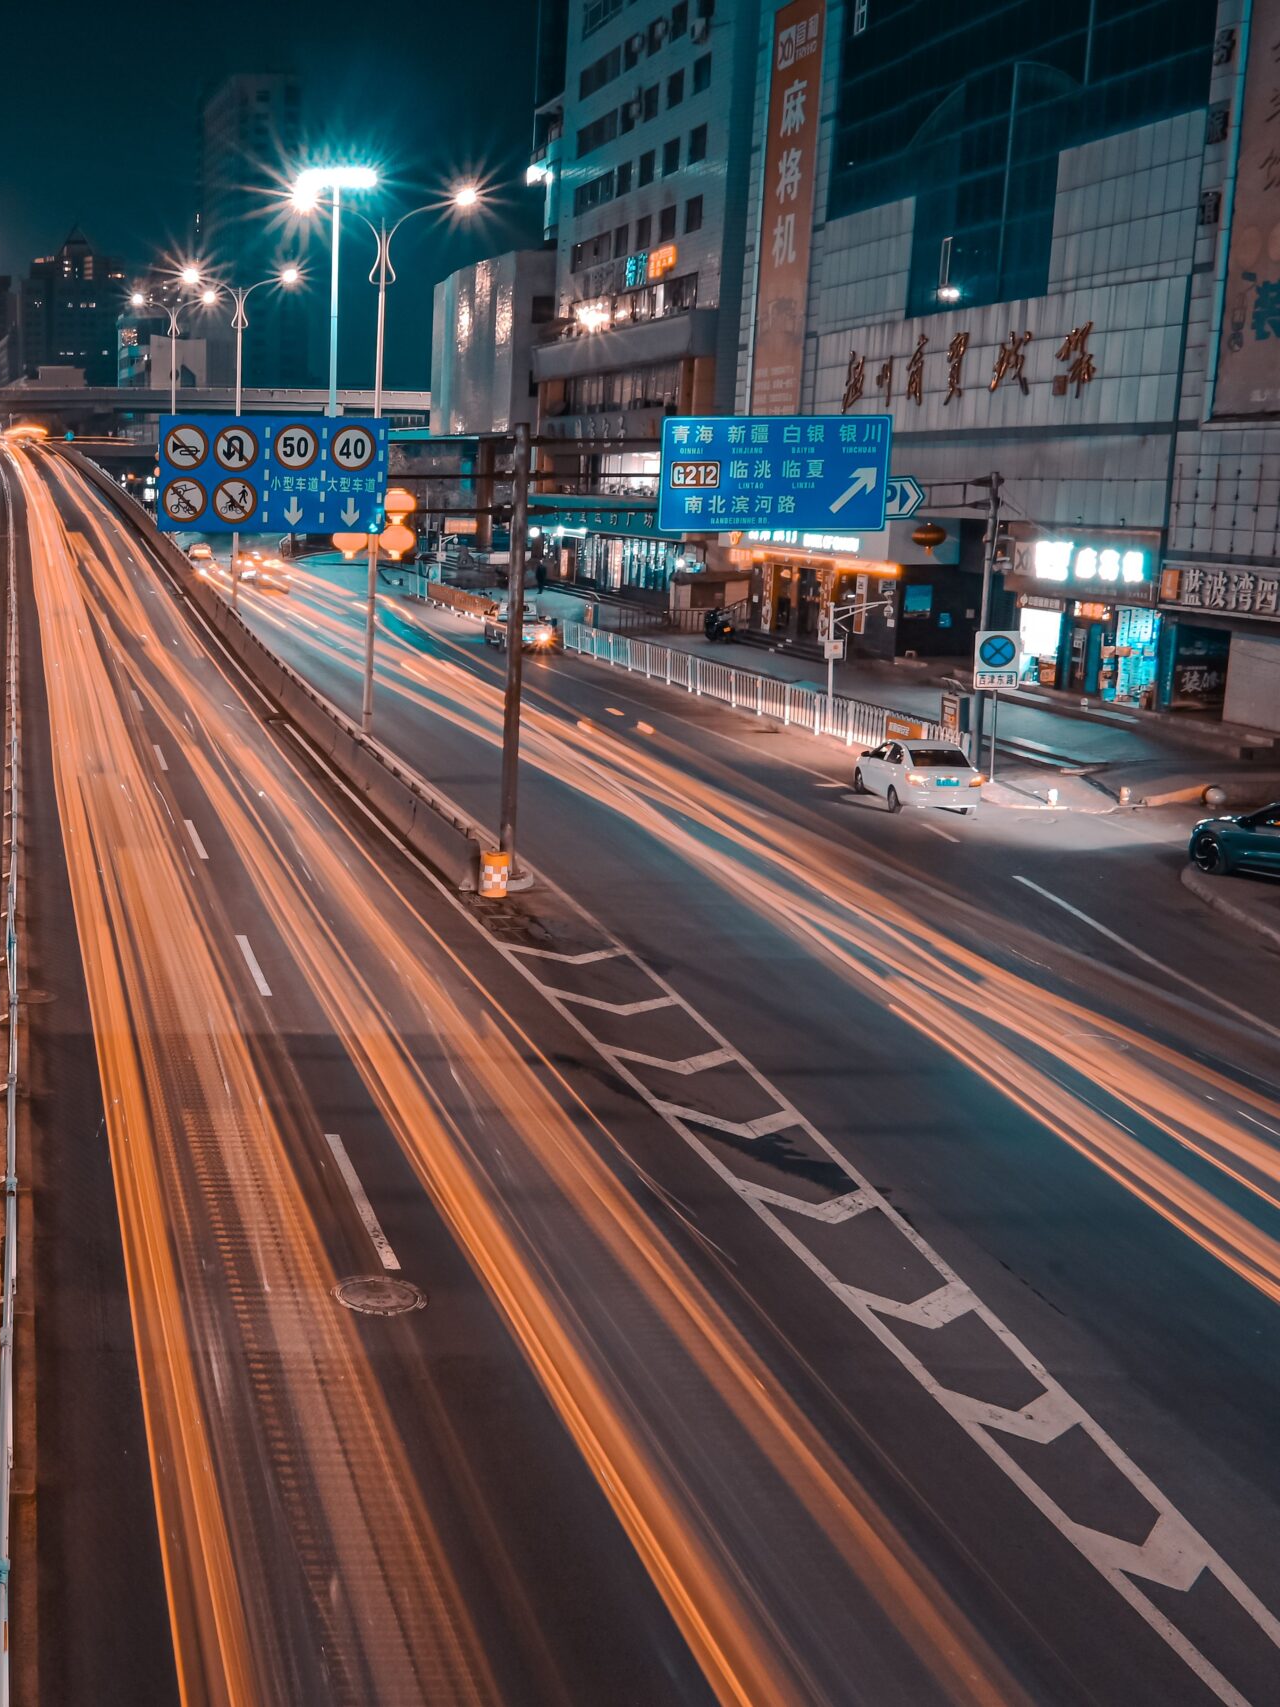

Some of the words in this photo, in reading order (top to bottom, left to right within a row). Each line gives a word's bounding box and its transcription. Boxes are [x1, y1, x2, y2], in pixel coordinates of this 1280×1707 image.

[772, 79, 808, 268] 麻将机
[672, 425, 714, 444] 青海
[728, 424, 769, 443] 新疆
[783, 424, 825, 443] 白银
[839, 423, 882, 443] 银川
[283, 437, 309, 458] 50
[339, 438, 366, 459] 40
[673, 465, 717, 485] G212
[729, 460, 772, 479] 临洮
[782, 459, 825, 478] 临夏
[270, 476, 319, 492] 小型车道
[327, 477, 376, 493] 大型车道
[684, 495, 796, 514] 南北滨河路
